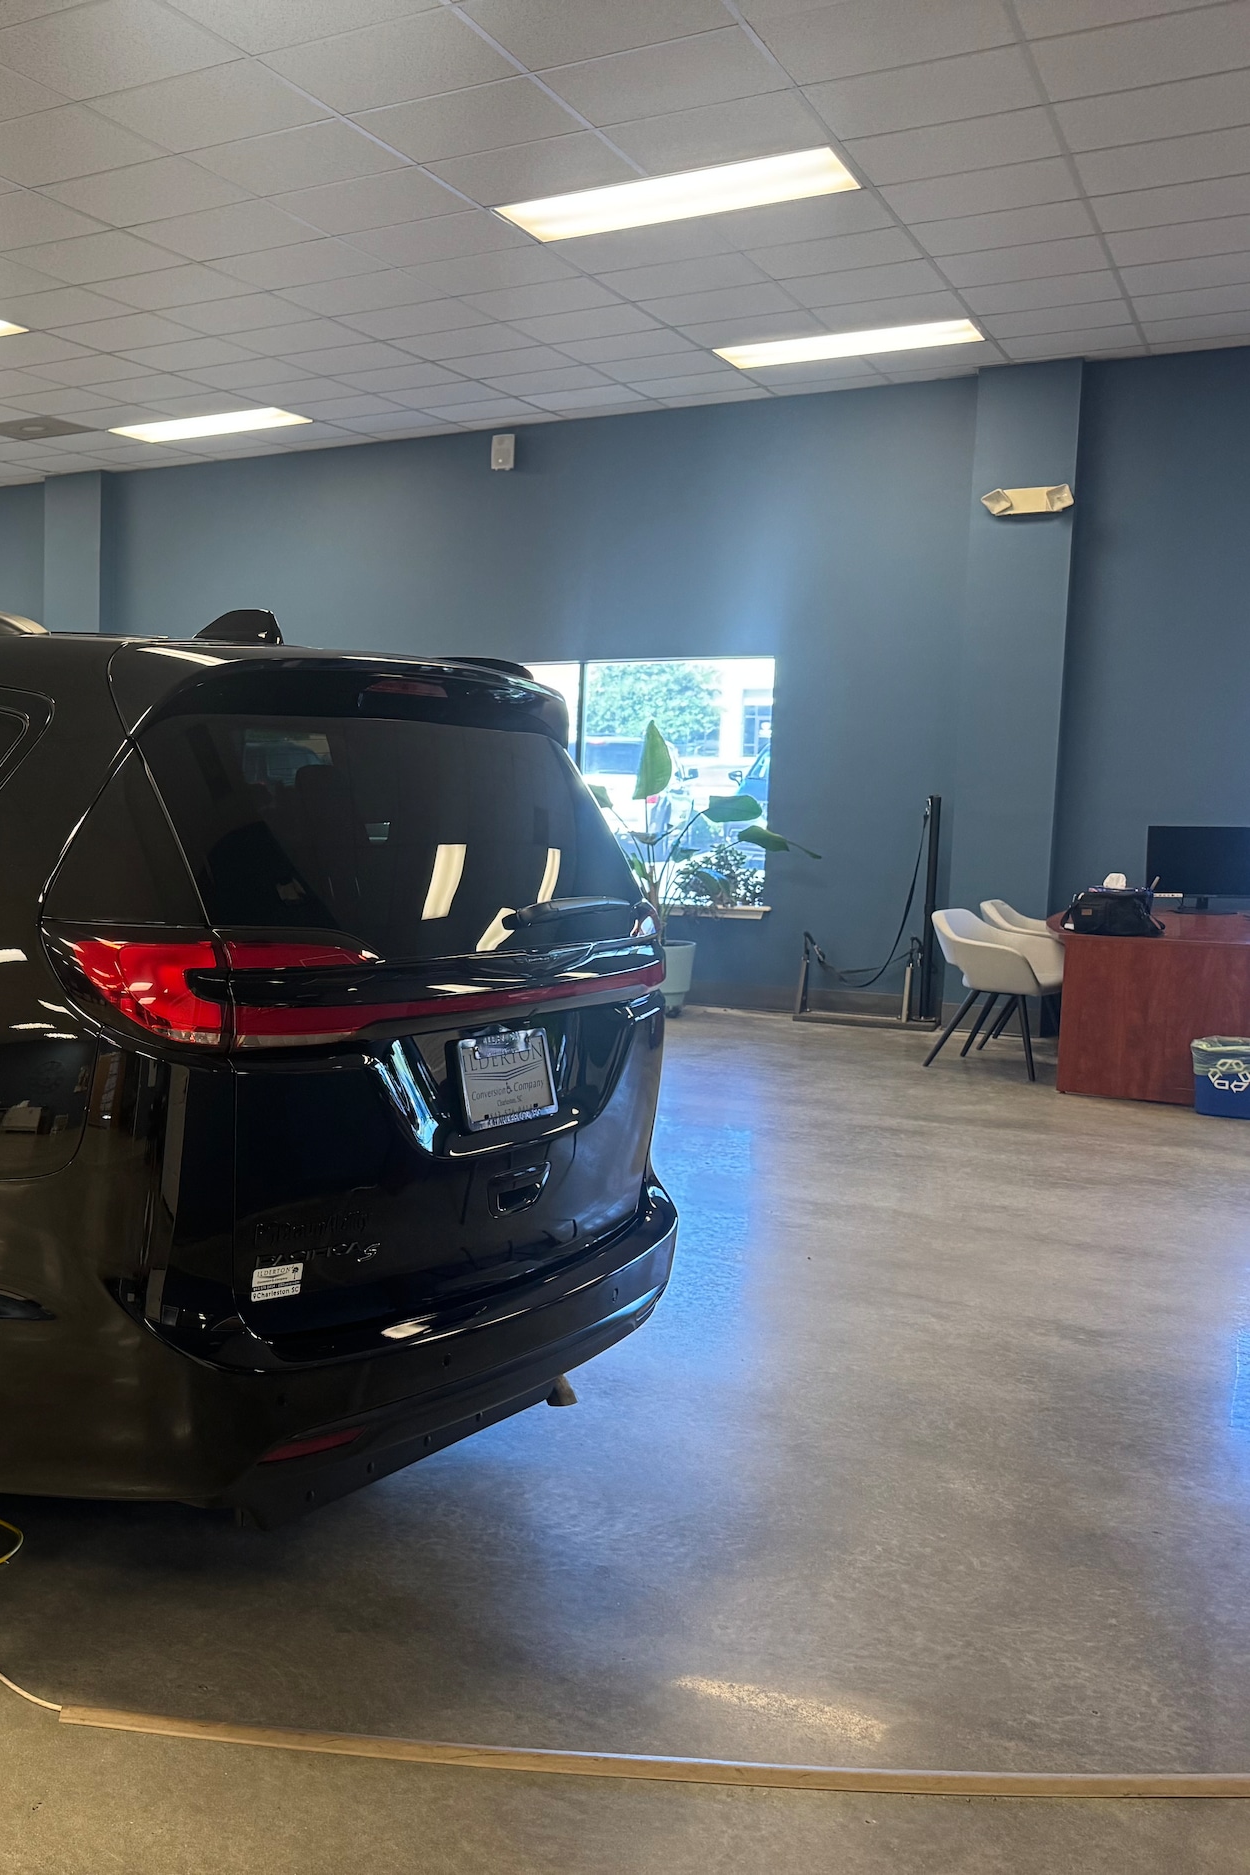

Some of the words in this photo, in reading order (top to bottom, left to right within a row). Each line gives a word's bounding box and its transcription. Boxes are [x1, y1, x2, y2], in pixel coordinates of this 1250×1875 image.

[471, 1087, 506, 1101] Conversion
[513, 1079, 544, 1092] Company
[257, 1289, 290, 1299] Charleston
